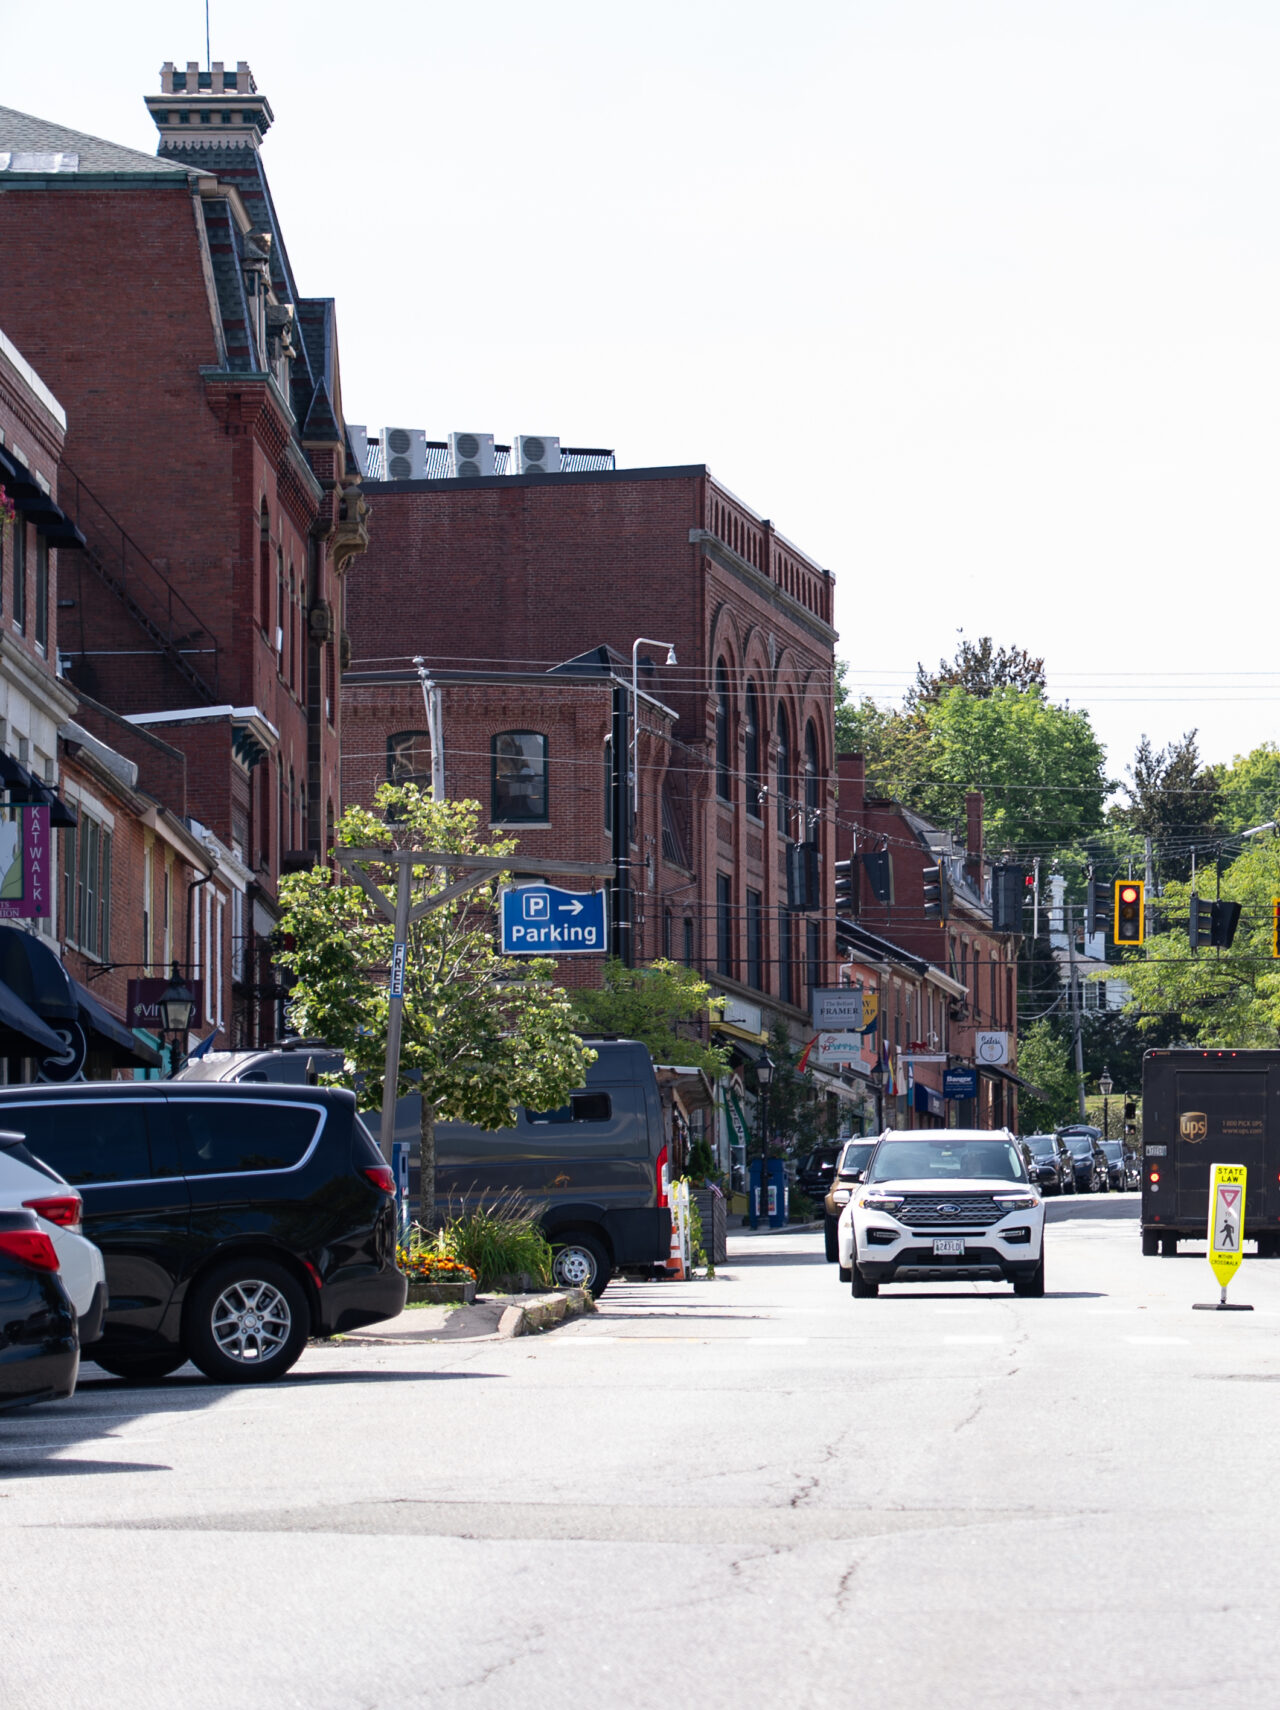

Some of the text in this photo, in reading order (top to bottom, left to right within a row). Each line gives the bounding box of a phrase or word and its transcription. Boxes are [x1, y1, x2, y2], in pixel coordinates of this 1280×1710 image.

[30, 806, 42, 900] KATWALK
[530, 898, 544, 916] P
[512, 924, 597, 945] Parking
[392, 945, 403, 995] FREE
[820, 1008, 860, 1016] FRAMER
[1182, 1121, 1206, 1139] ups
